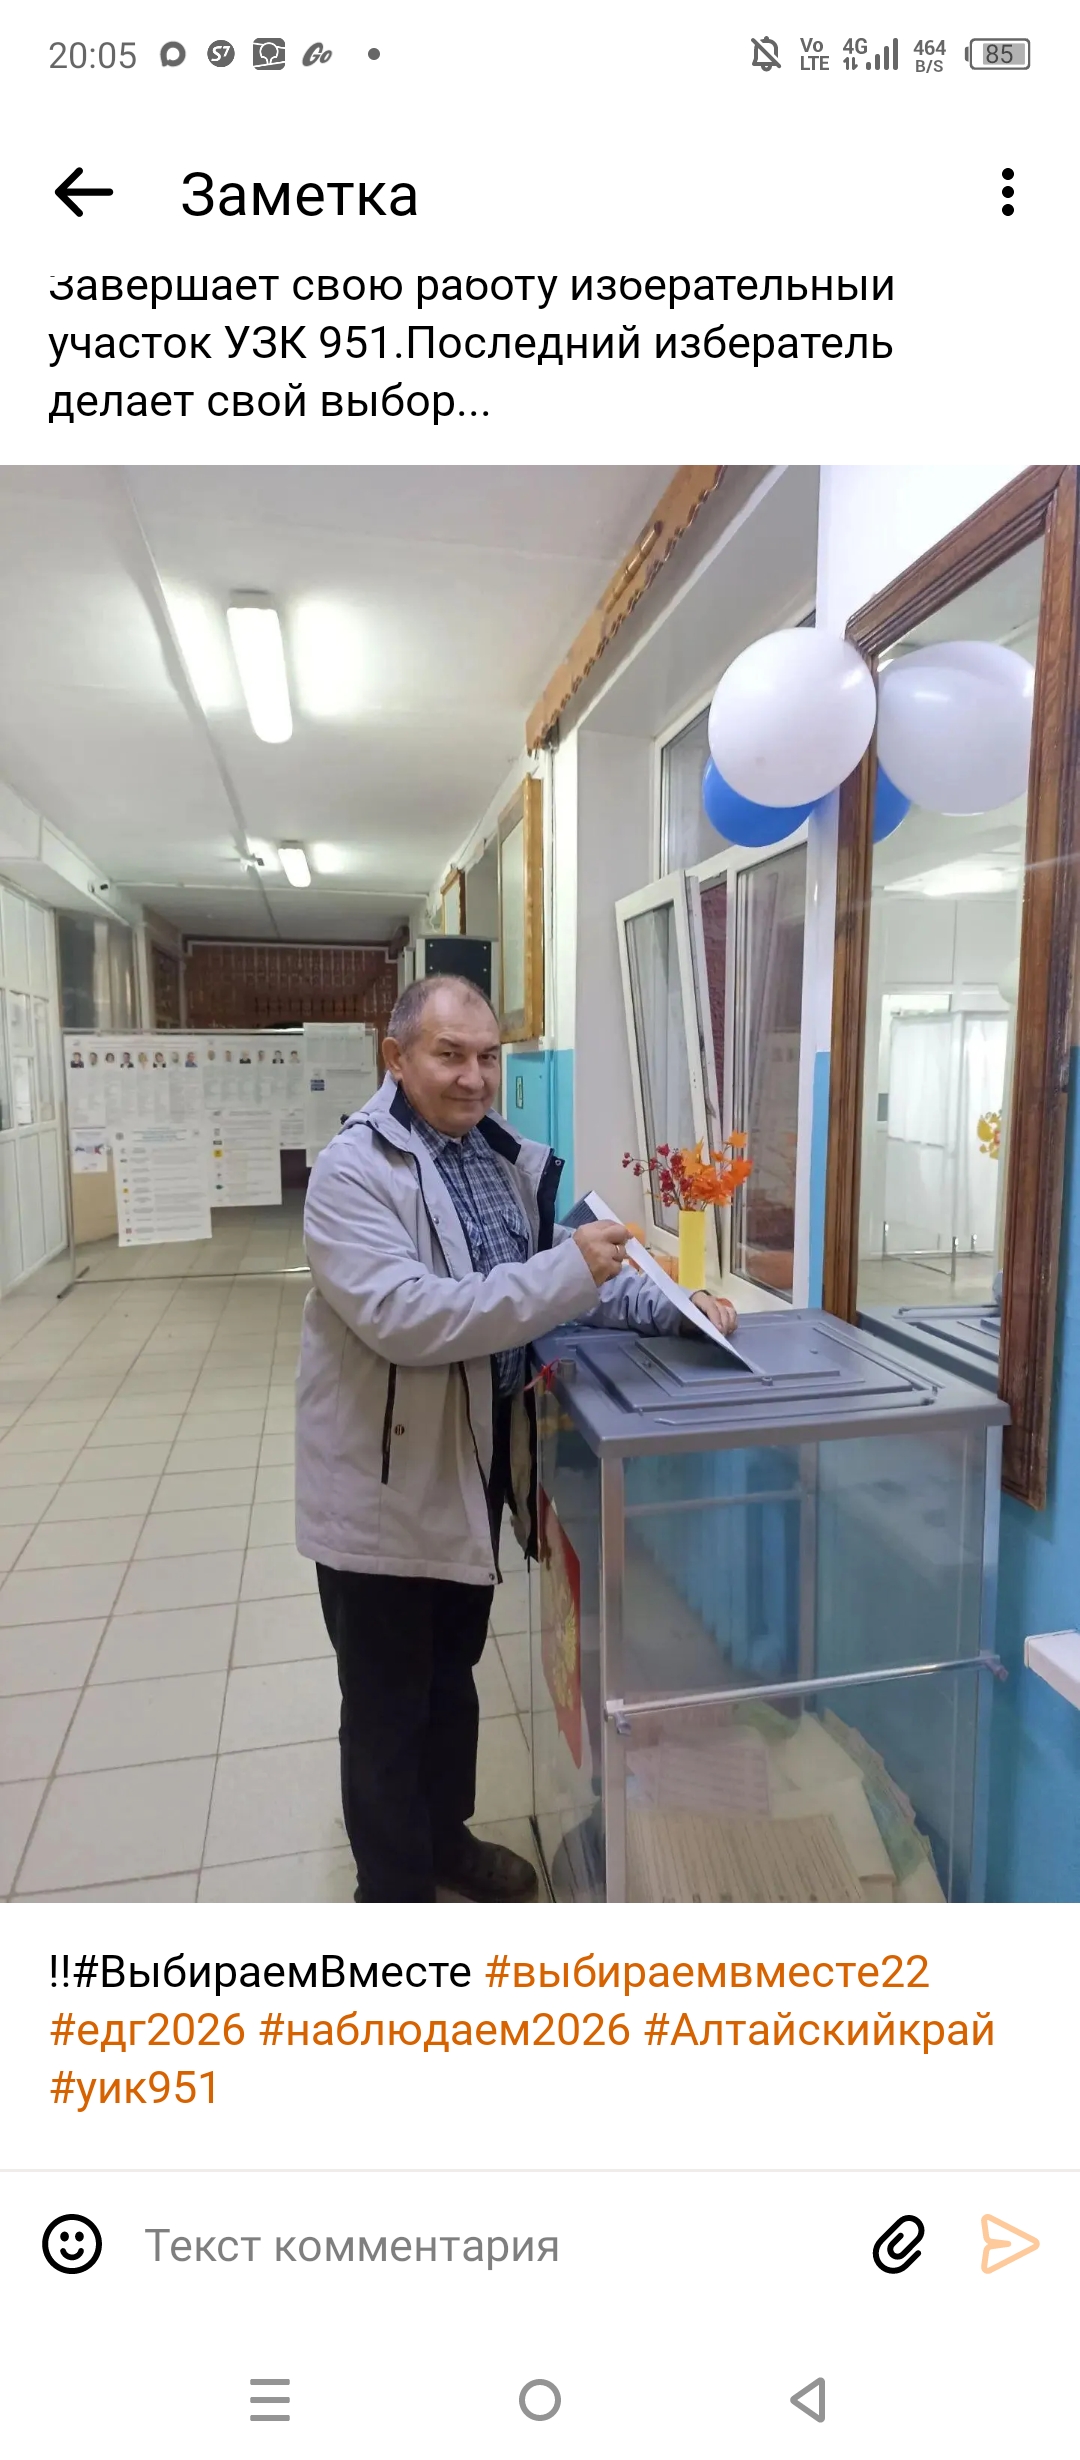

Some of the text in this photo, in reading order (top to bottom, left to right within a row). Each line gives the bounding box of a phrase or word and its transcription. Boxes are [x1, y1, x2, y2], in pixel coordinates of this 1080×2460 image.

[50, 42, 137, 69] 20:05
[800, 38, 824, 53] Vo
[843, 38, 868, 54] 4G
[913, 40, 947, 56] 464
[985, 44, 1014, 64] 85
[800, 56, 830, 71] LTE
[915, 60, 944, 73] B/S
[182, 172, 418, 217] Заметка
[50, 276, 280, 309] Завершает
[293, 276, 403, 301] свою
[418, 276, 559, 309] работу
[48, 324, 893, 367] участок УЗК 951.Последний избератель
[49, 382, 489, 425] делает свой выбор...
[51, 1953, 930, 1996] !!#ВыбираемВместе #выбираемвместе22
[50, 2011, 994, 2054] #едг2026 #наблюдаем2026 #Алтайскийкрай
[50, 2071, 217, 2112] #уик951
[145, 2229, 558, 2270] Текст комментария
